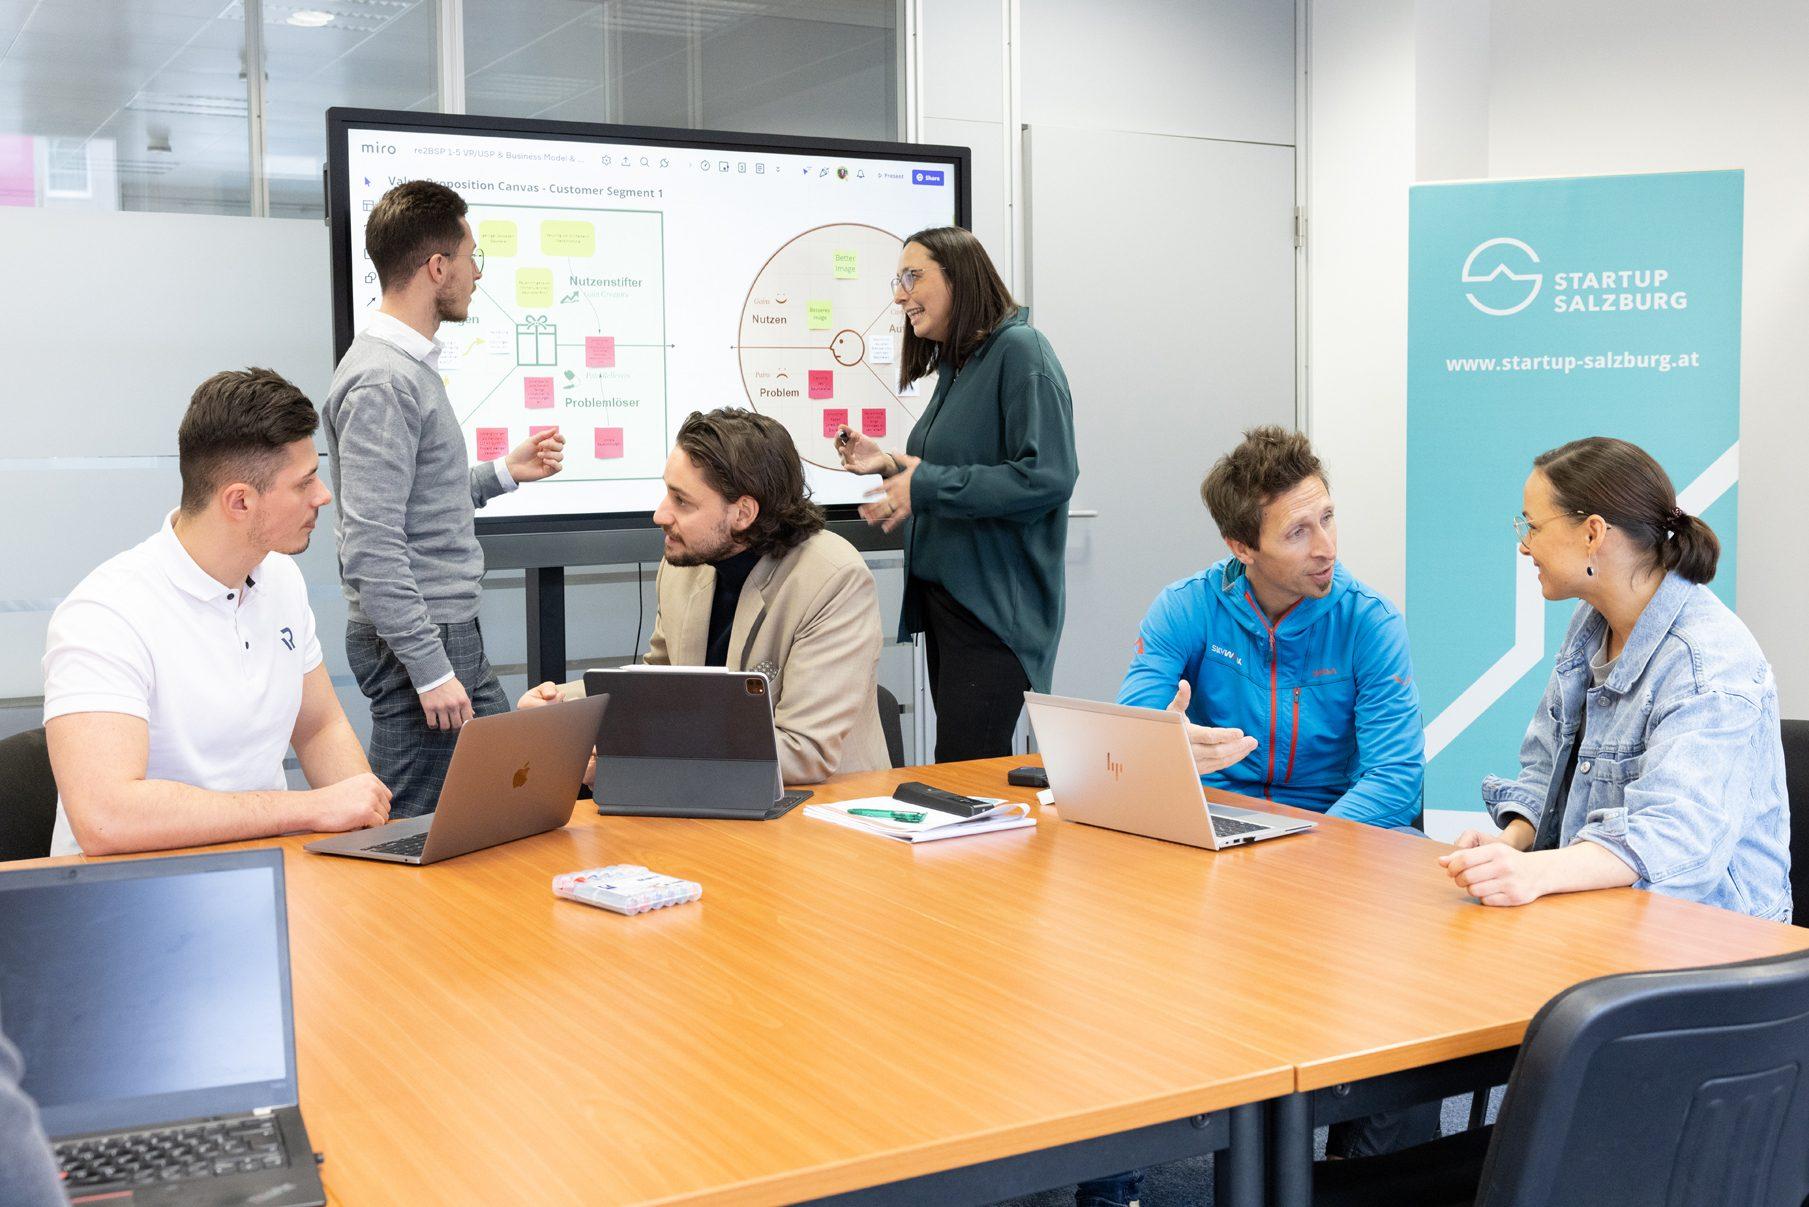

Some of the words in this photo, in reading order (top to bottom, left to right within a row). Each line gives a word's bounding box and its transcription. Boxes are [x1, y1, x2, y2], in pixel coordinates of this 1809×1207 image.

[361, 141, 396, 154] miro
[506, 151, 542, 161] Business
[544, 153, 568, 163] Model
[426, 177, 495, 191] Poposition
[498, 181, 539, 193] Canvas
[549, 183, 605, 196] Customer
[606, 186, 655, 199] Segment
[658, 188, 664, 198] 1
[835, 254, 856, 262] Better
[569, 275, 643, 288] Nutzenstifter
[1553, 269, 1669, 291] STARTUP
[1553, 290, 1688, 313] SALZBURG
[752, 314, 787, 324] Nutzen
[1445, 351, 1700, 374] www.startup-salzburg.at
[760, 387, 800, 398] Problem
[565, 397, 640, 408] Problemlöser
